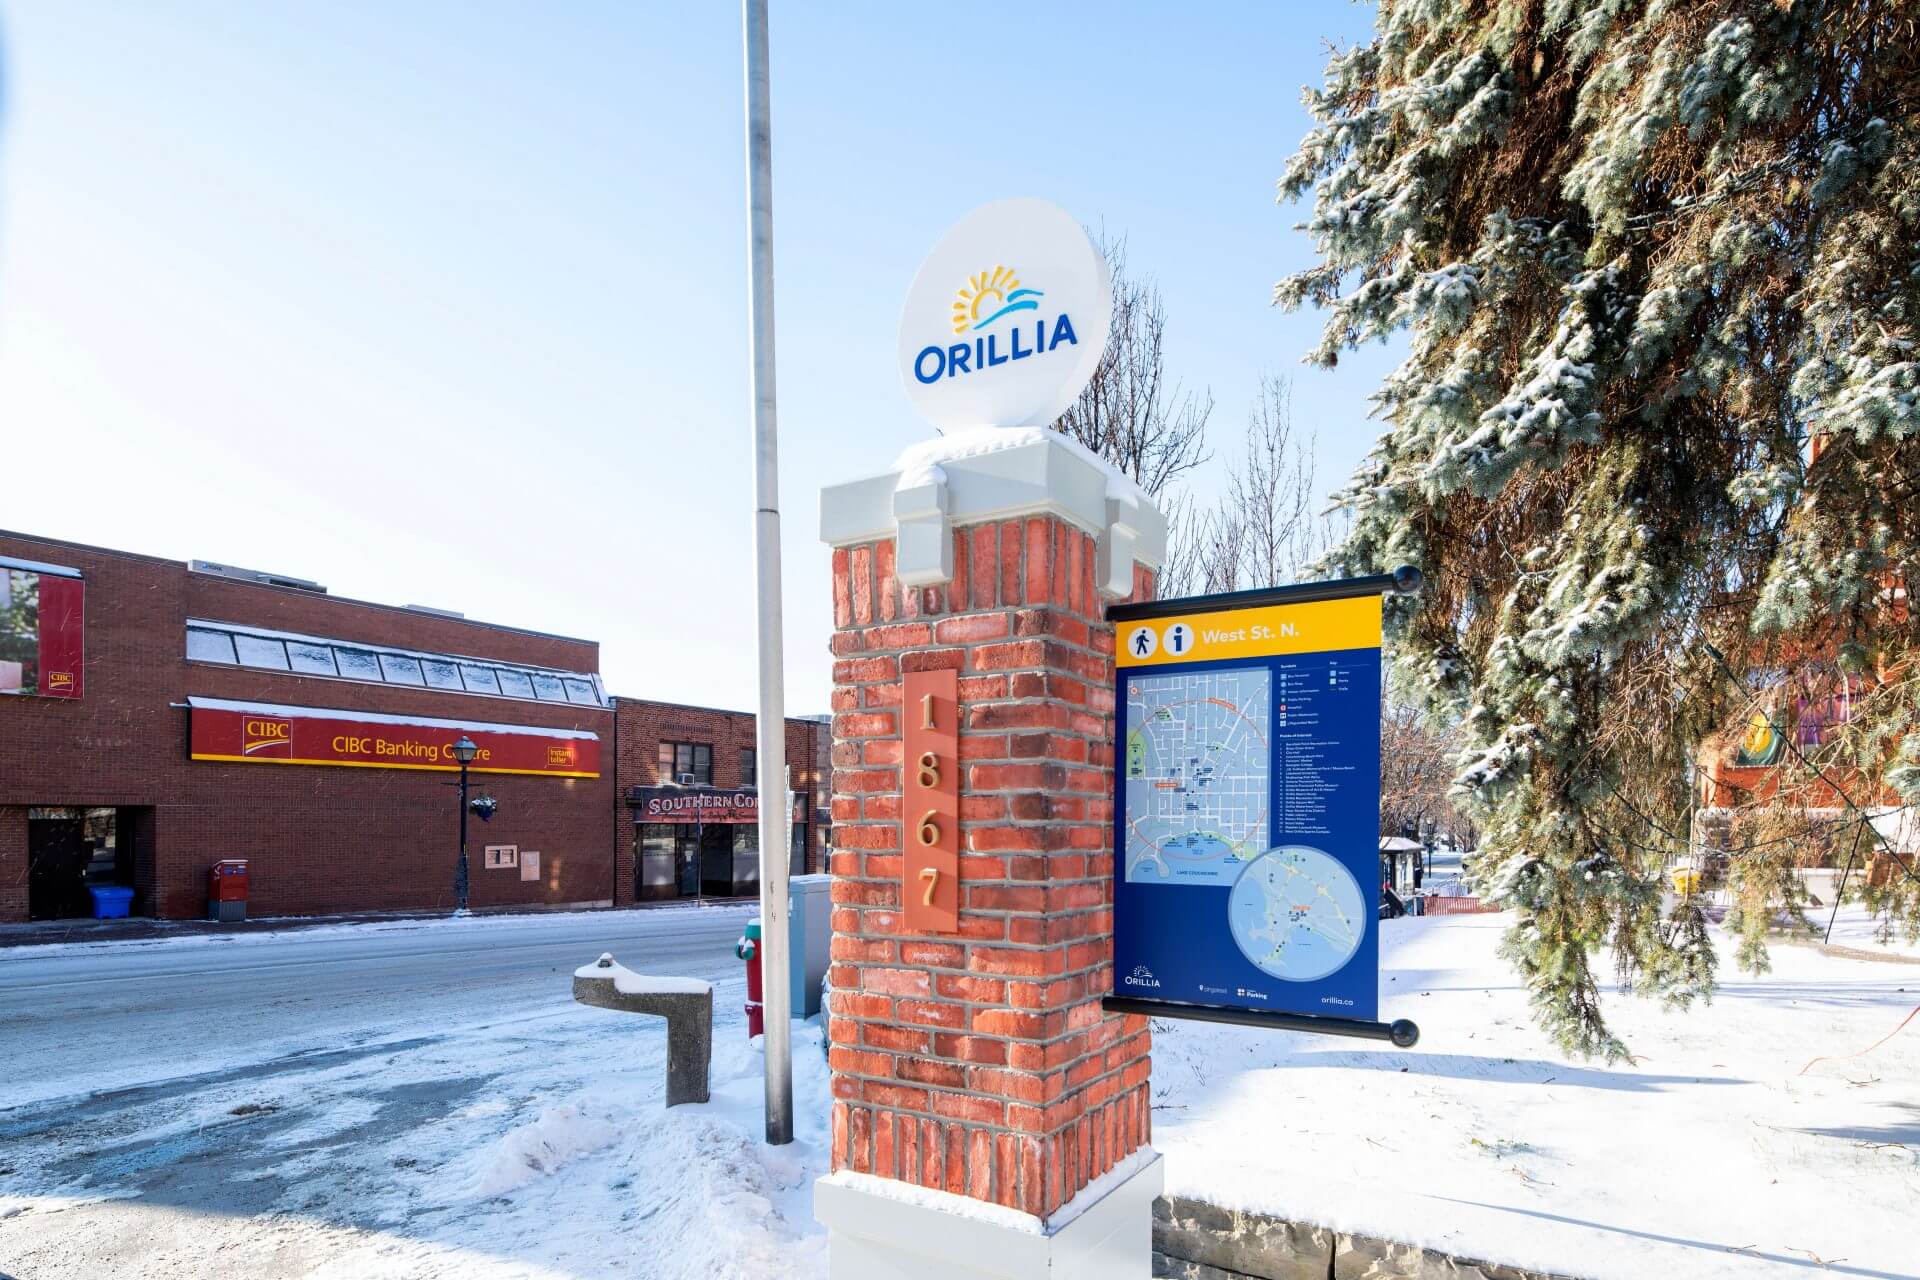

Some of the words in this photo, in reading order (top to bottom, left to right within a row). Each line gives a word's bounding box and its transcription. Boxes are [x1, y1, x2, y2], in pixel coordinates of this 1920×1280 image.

[914, 313, 1078, 385] ORILLIA
[1202, 629, 1246, 645] West
[1250, 625, 1276, 641] St.
[1280, 623, 1300, 638] N.
[50, 673, 72, 681] CIBC
[247, 721, 289, 738] CIBC
[332, 736, 372, 754] CIBC
[376, 739, 438, 761] Banking
[442, 743, 491, 761] Cre
[648, 795, 732, 815] SOUTHERN
[734, 793, 759, 808] CO
[1124, 976, 1161, 988] ORILLIA
[1321, 996, 1354, 1006] orillia.ca
